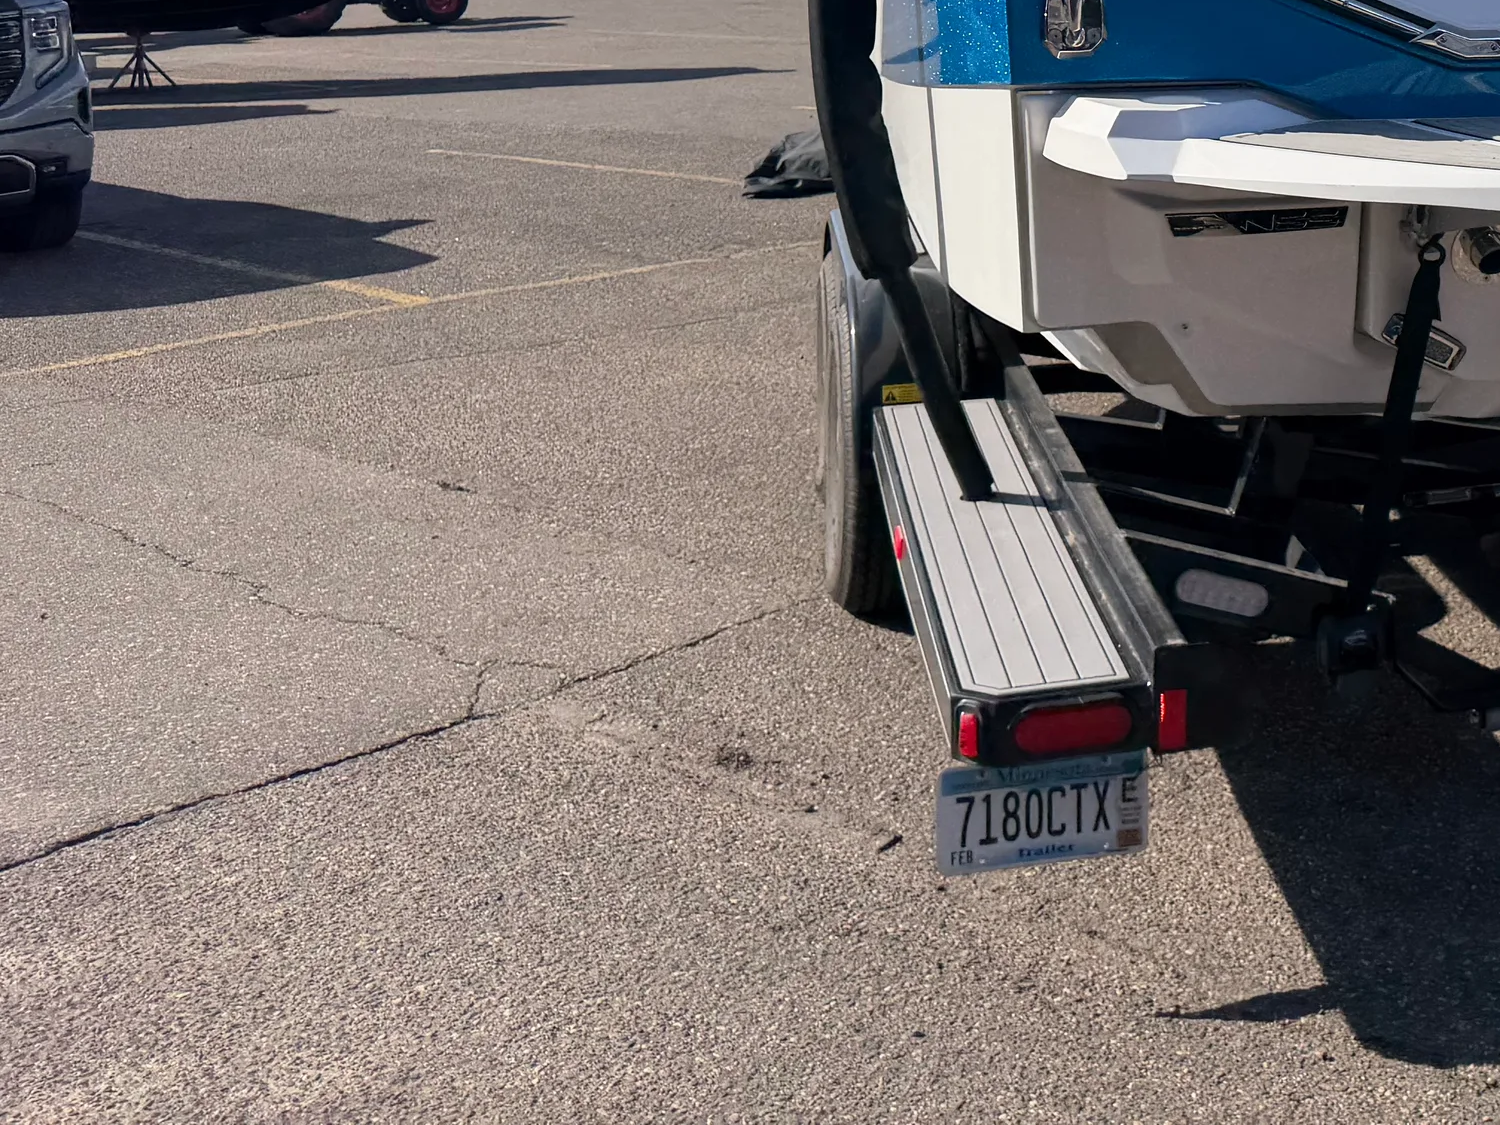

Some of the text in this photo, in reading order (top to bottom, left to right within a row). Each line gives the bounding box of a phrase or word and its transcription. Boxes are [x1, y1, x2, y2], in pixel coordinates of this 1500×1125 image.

[955, 779, 1111, 848] 7180CTX
[951, 850, 973, 866] FEB
[1018, 843, 1076, 859] Trailer
